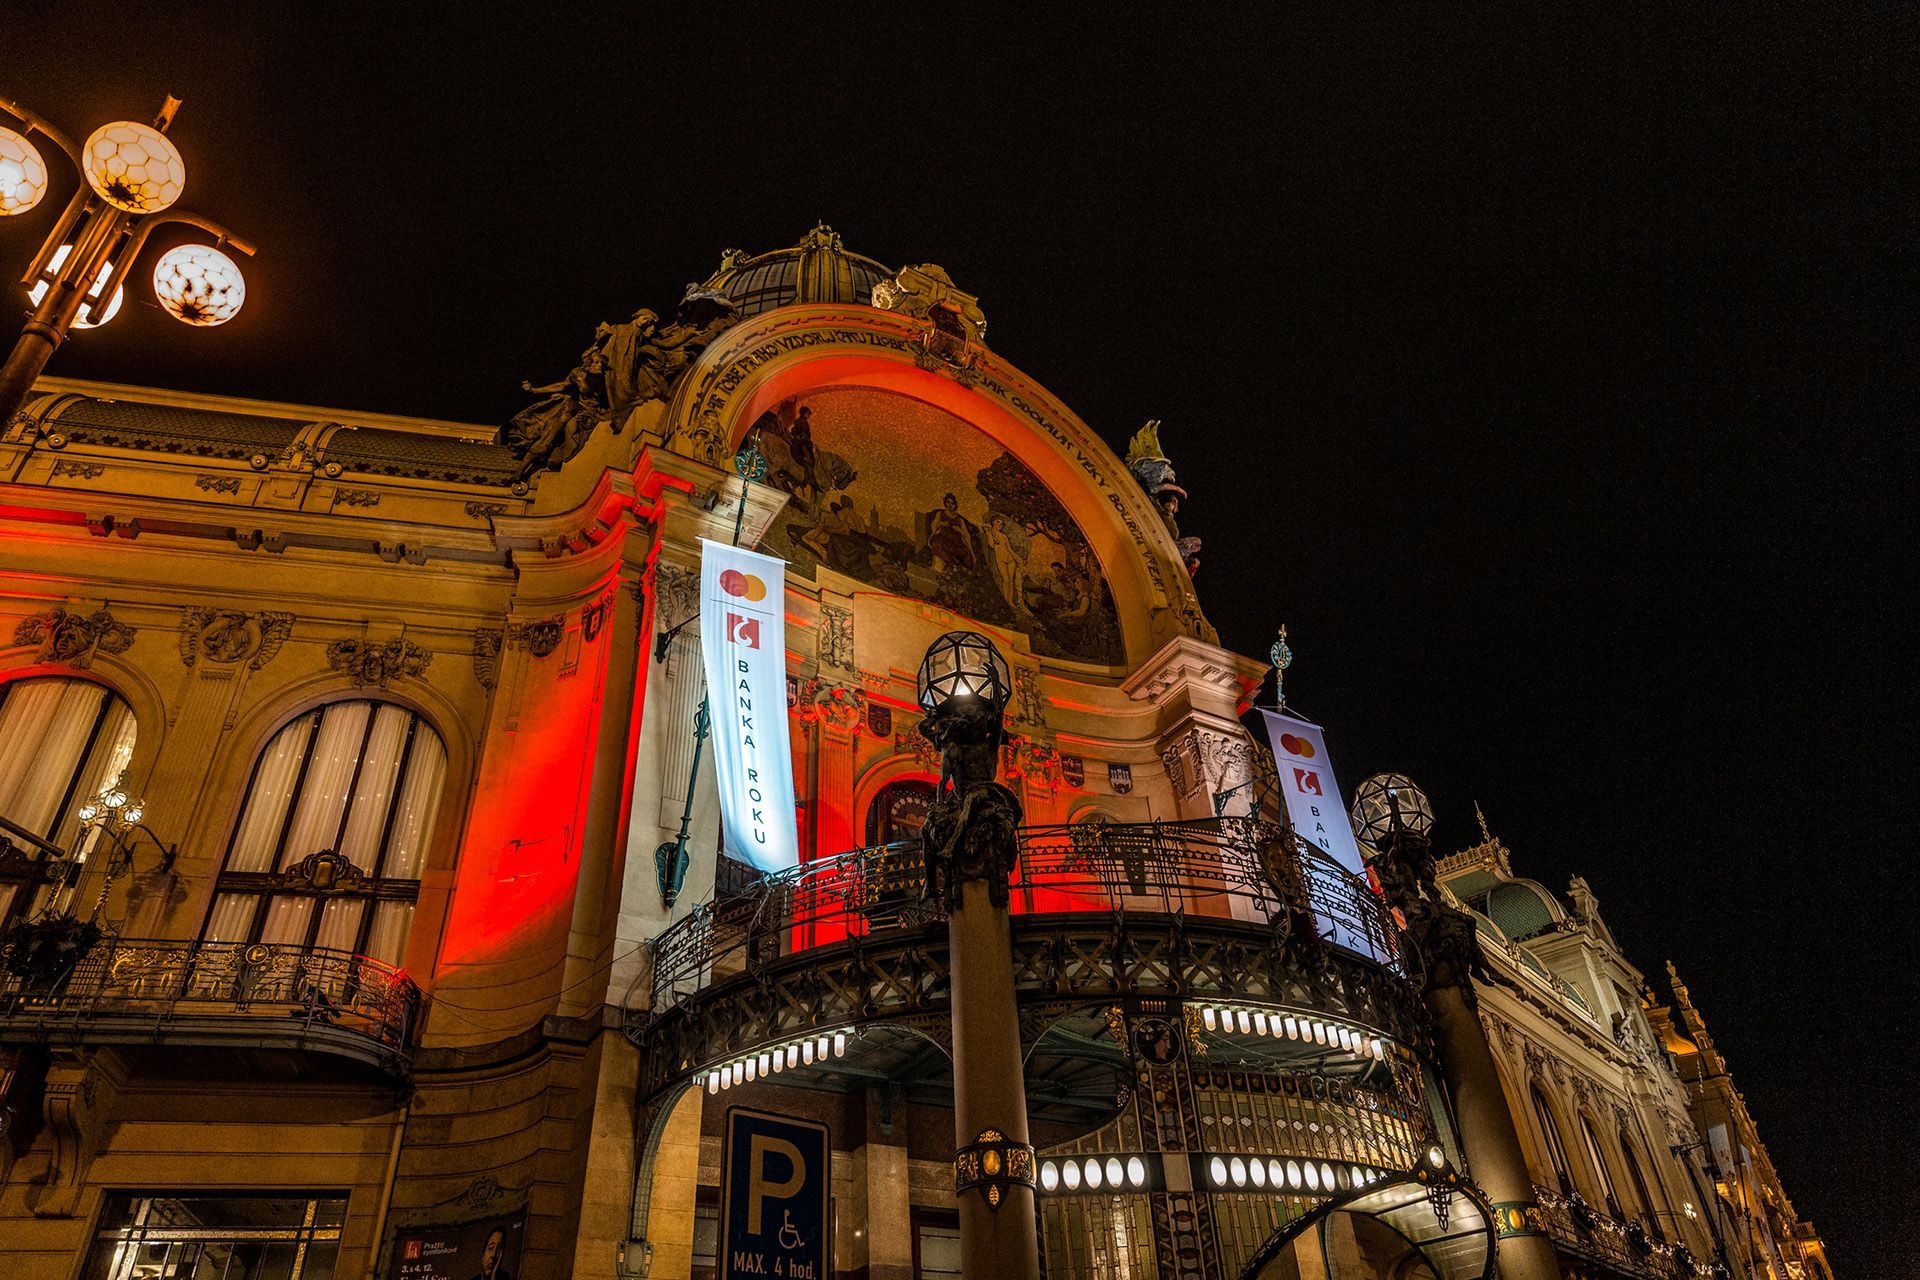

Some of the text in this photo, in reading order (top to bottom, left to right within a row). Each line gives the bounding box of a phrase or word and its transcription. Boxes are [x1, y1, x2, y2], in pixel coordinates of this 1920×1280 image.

[738, 659, 766, 844] BANKA ROKU
[748, 1134, 806, 1235] P
[733, 1251, 767, 1275] MAX.
[774, 1256, 783, 1276] 4
